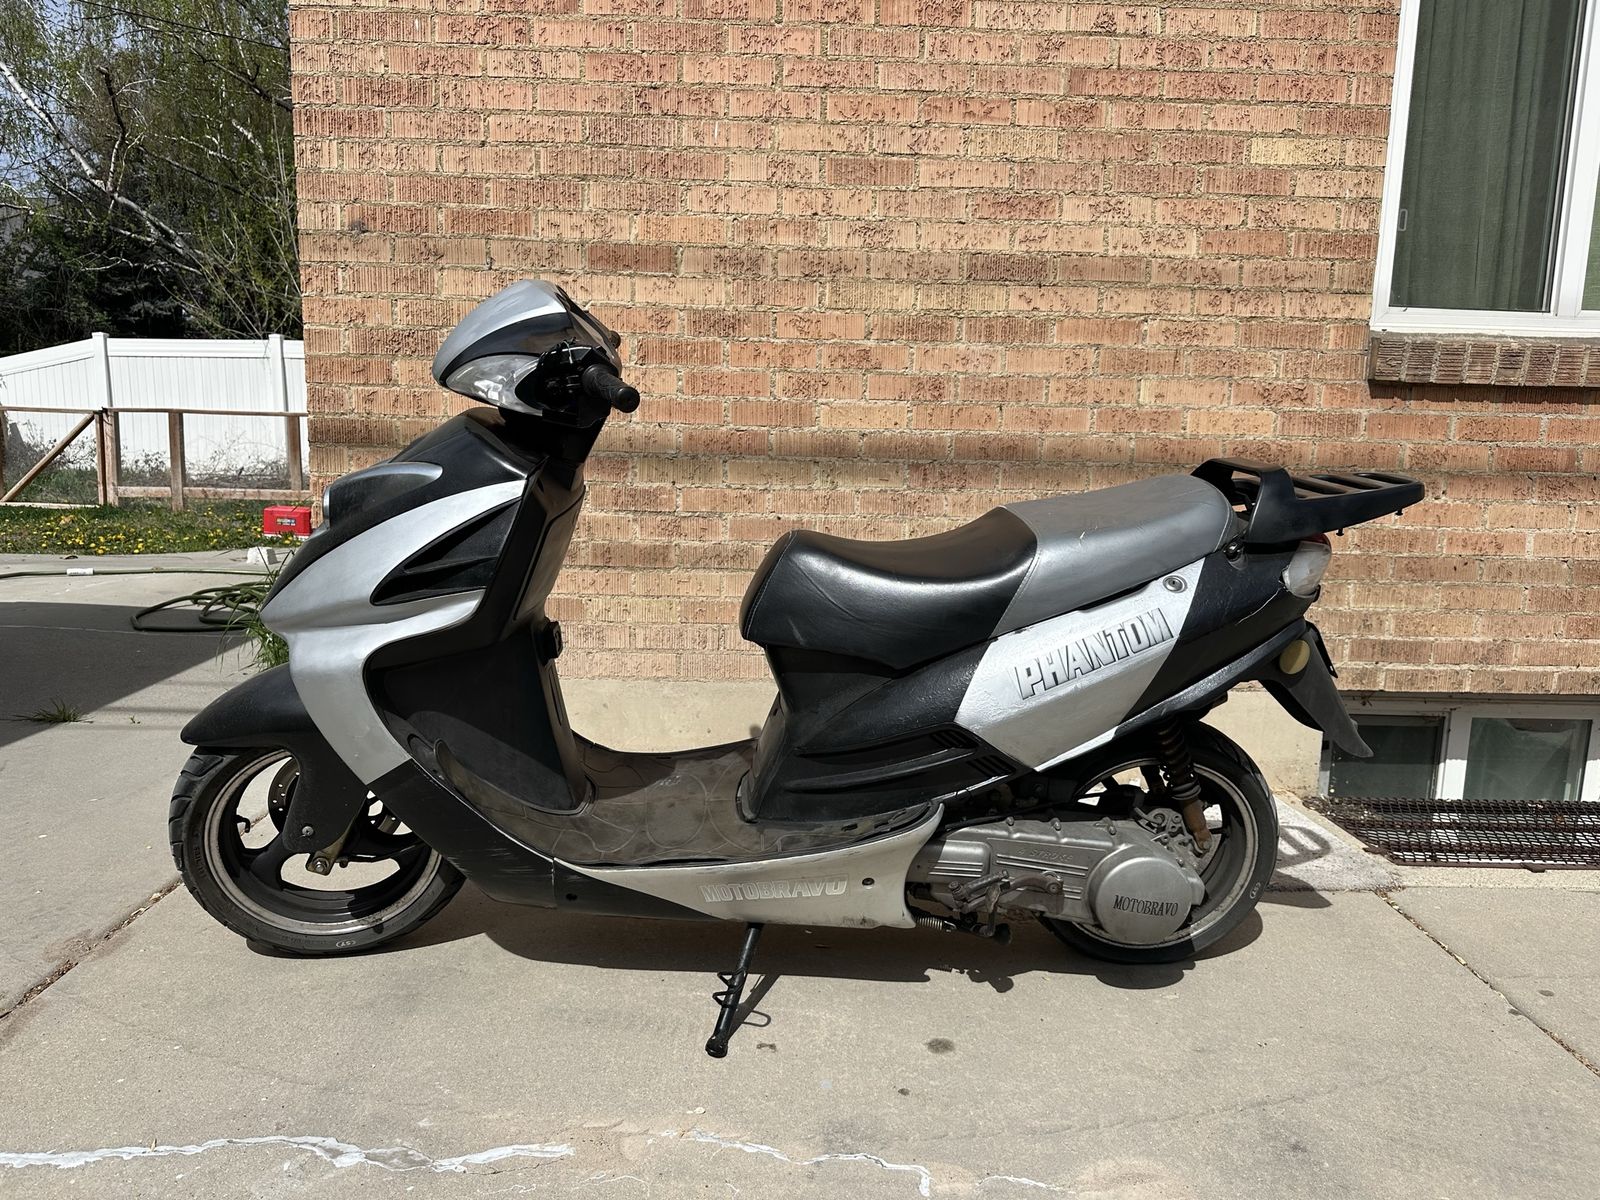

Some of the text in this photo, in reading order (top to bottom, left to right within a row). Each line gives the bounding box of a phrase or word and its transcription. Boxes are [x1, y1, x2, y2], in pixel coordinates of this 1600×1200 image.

[1013, 607, 1174, 700] PHANTOM
[700, 877, 848, 903] MOTOBRAVO
[1112, 894, 1179, 917] MOTOBRAVO
